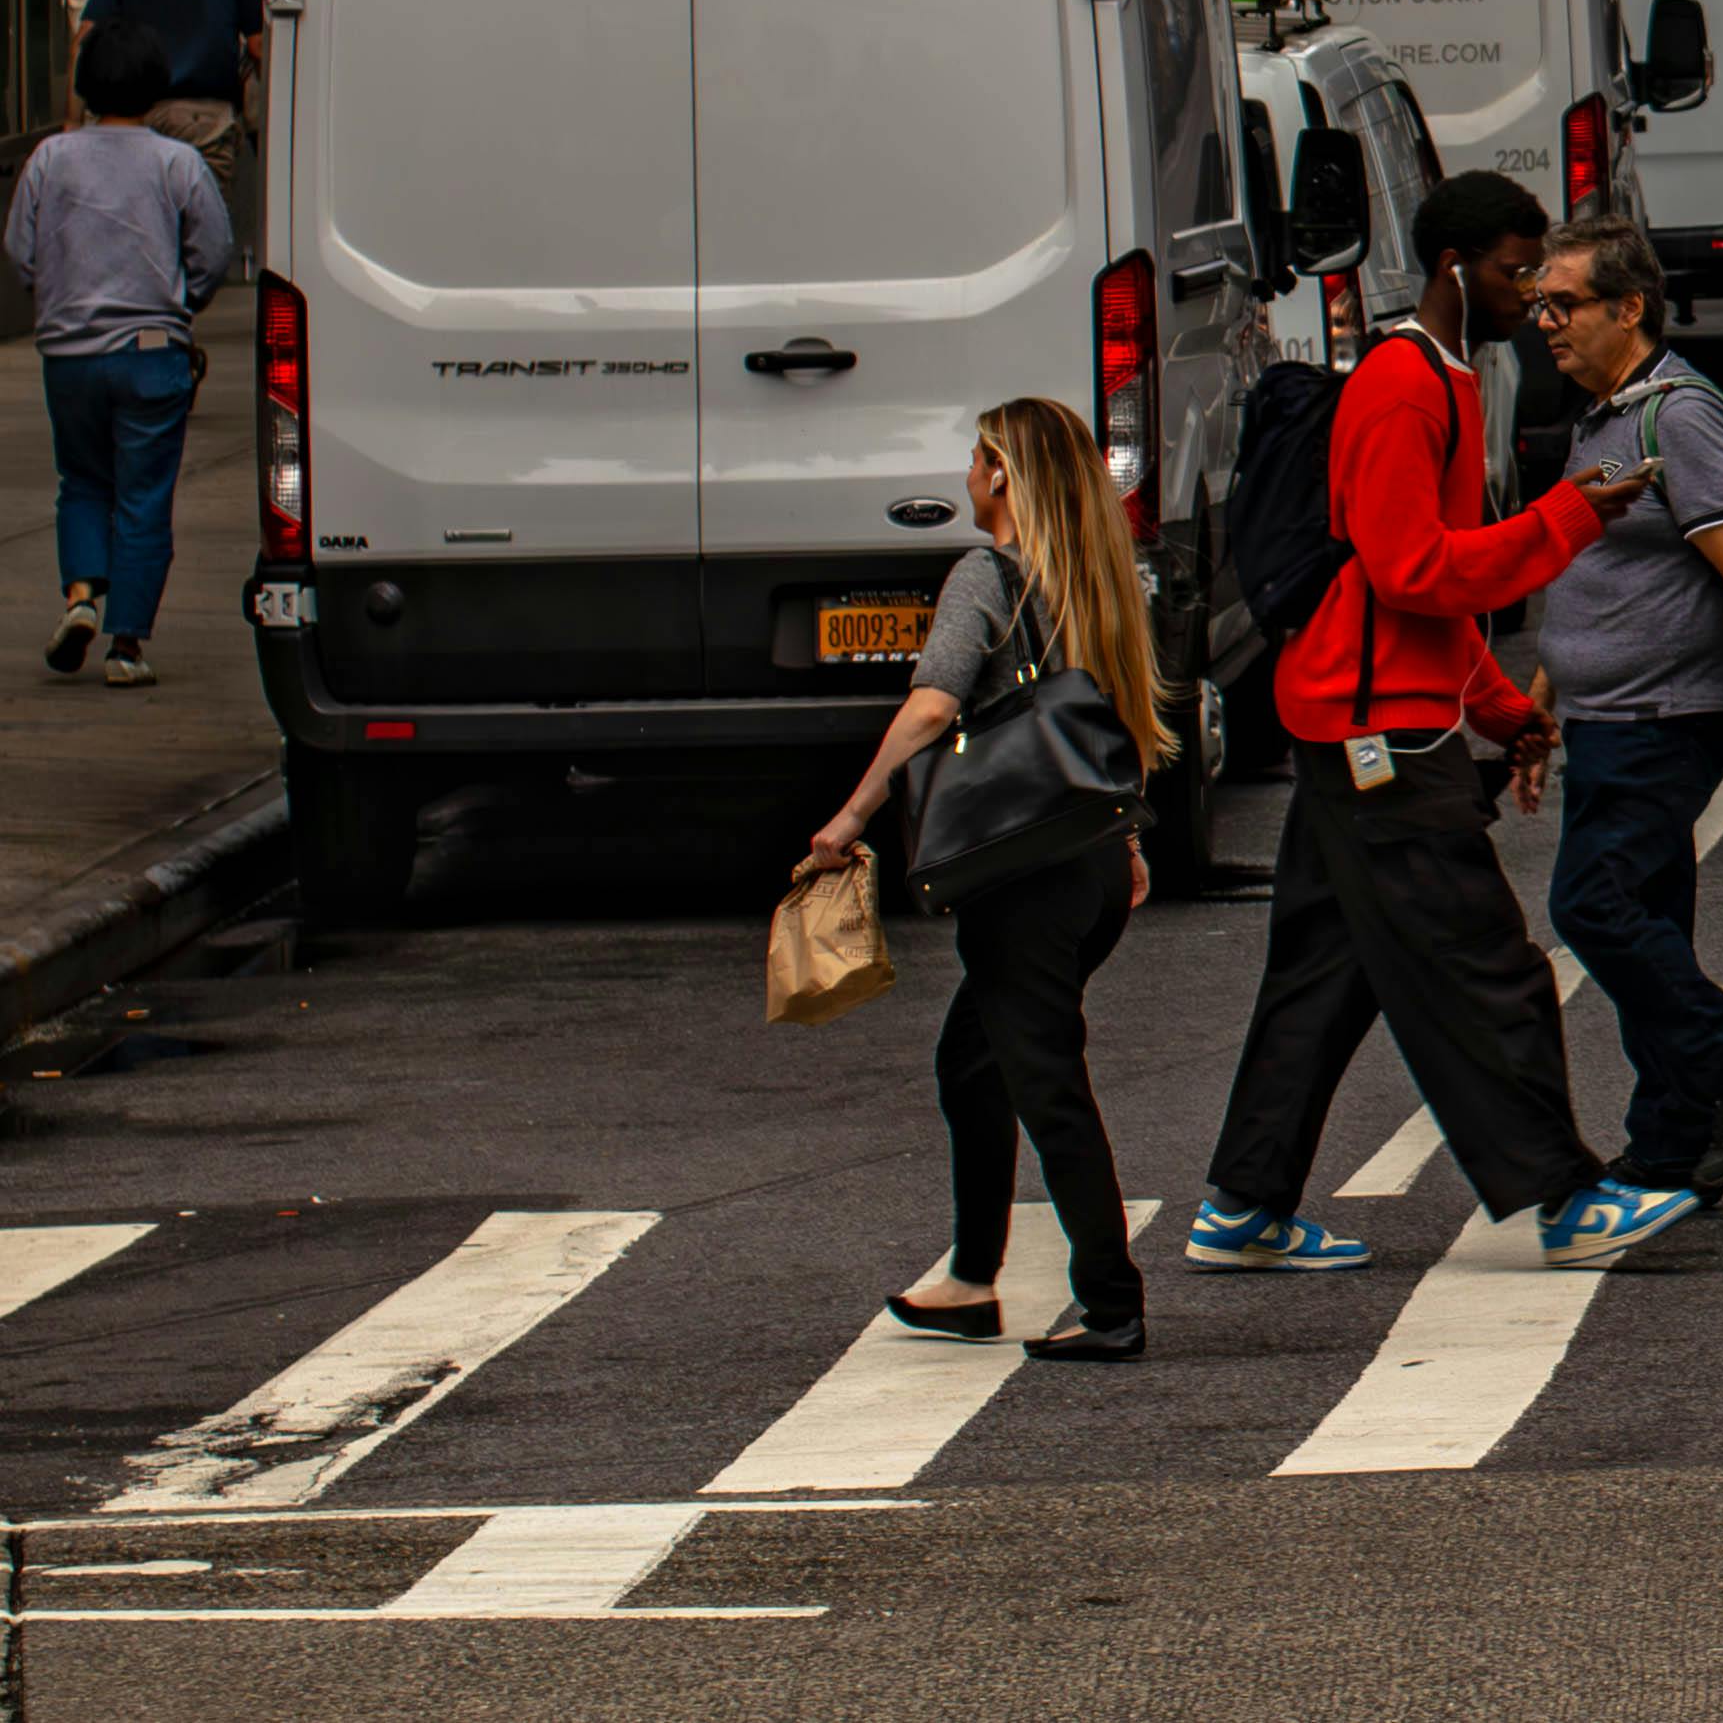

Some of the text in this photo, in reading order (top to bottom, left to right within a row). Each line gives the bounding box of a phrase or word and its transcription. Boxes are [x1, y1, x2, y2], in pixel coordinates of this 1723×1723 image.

[1391, 43, 1502, 66] RE.COM
[1494, 148, 1551, 173] 2204
[431, 359, 690, 378] TRANSIT 350HD
[828, 612, 936, 648] 80093-M
